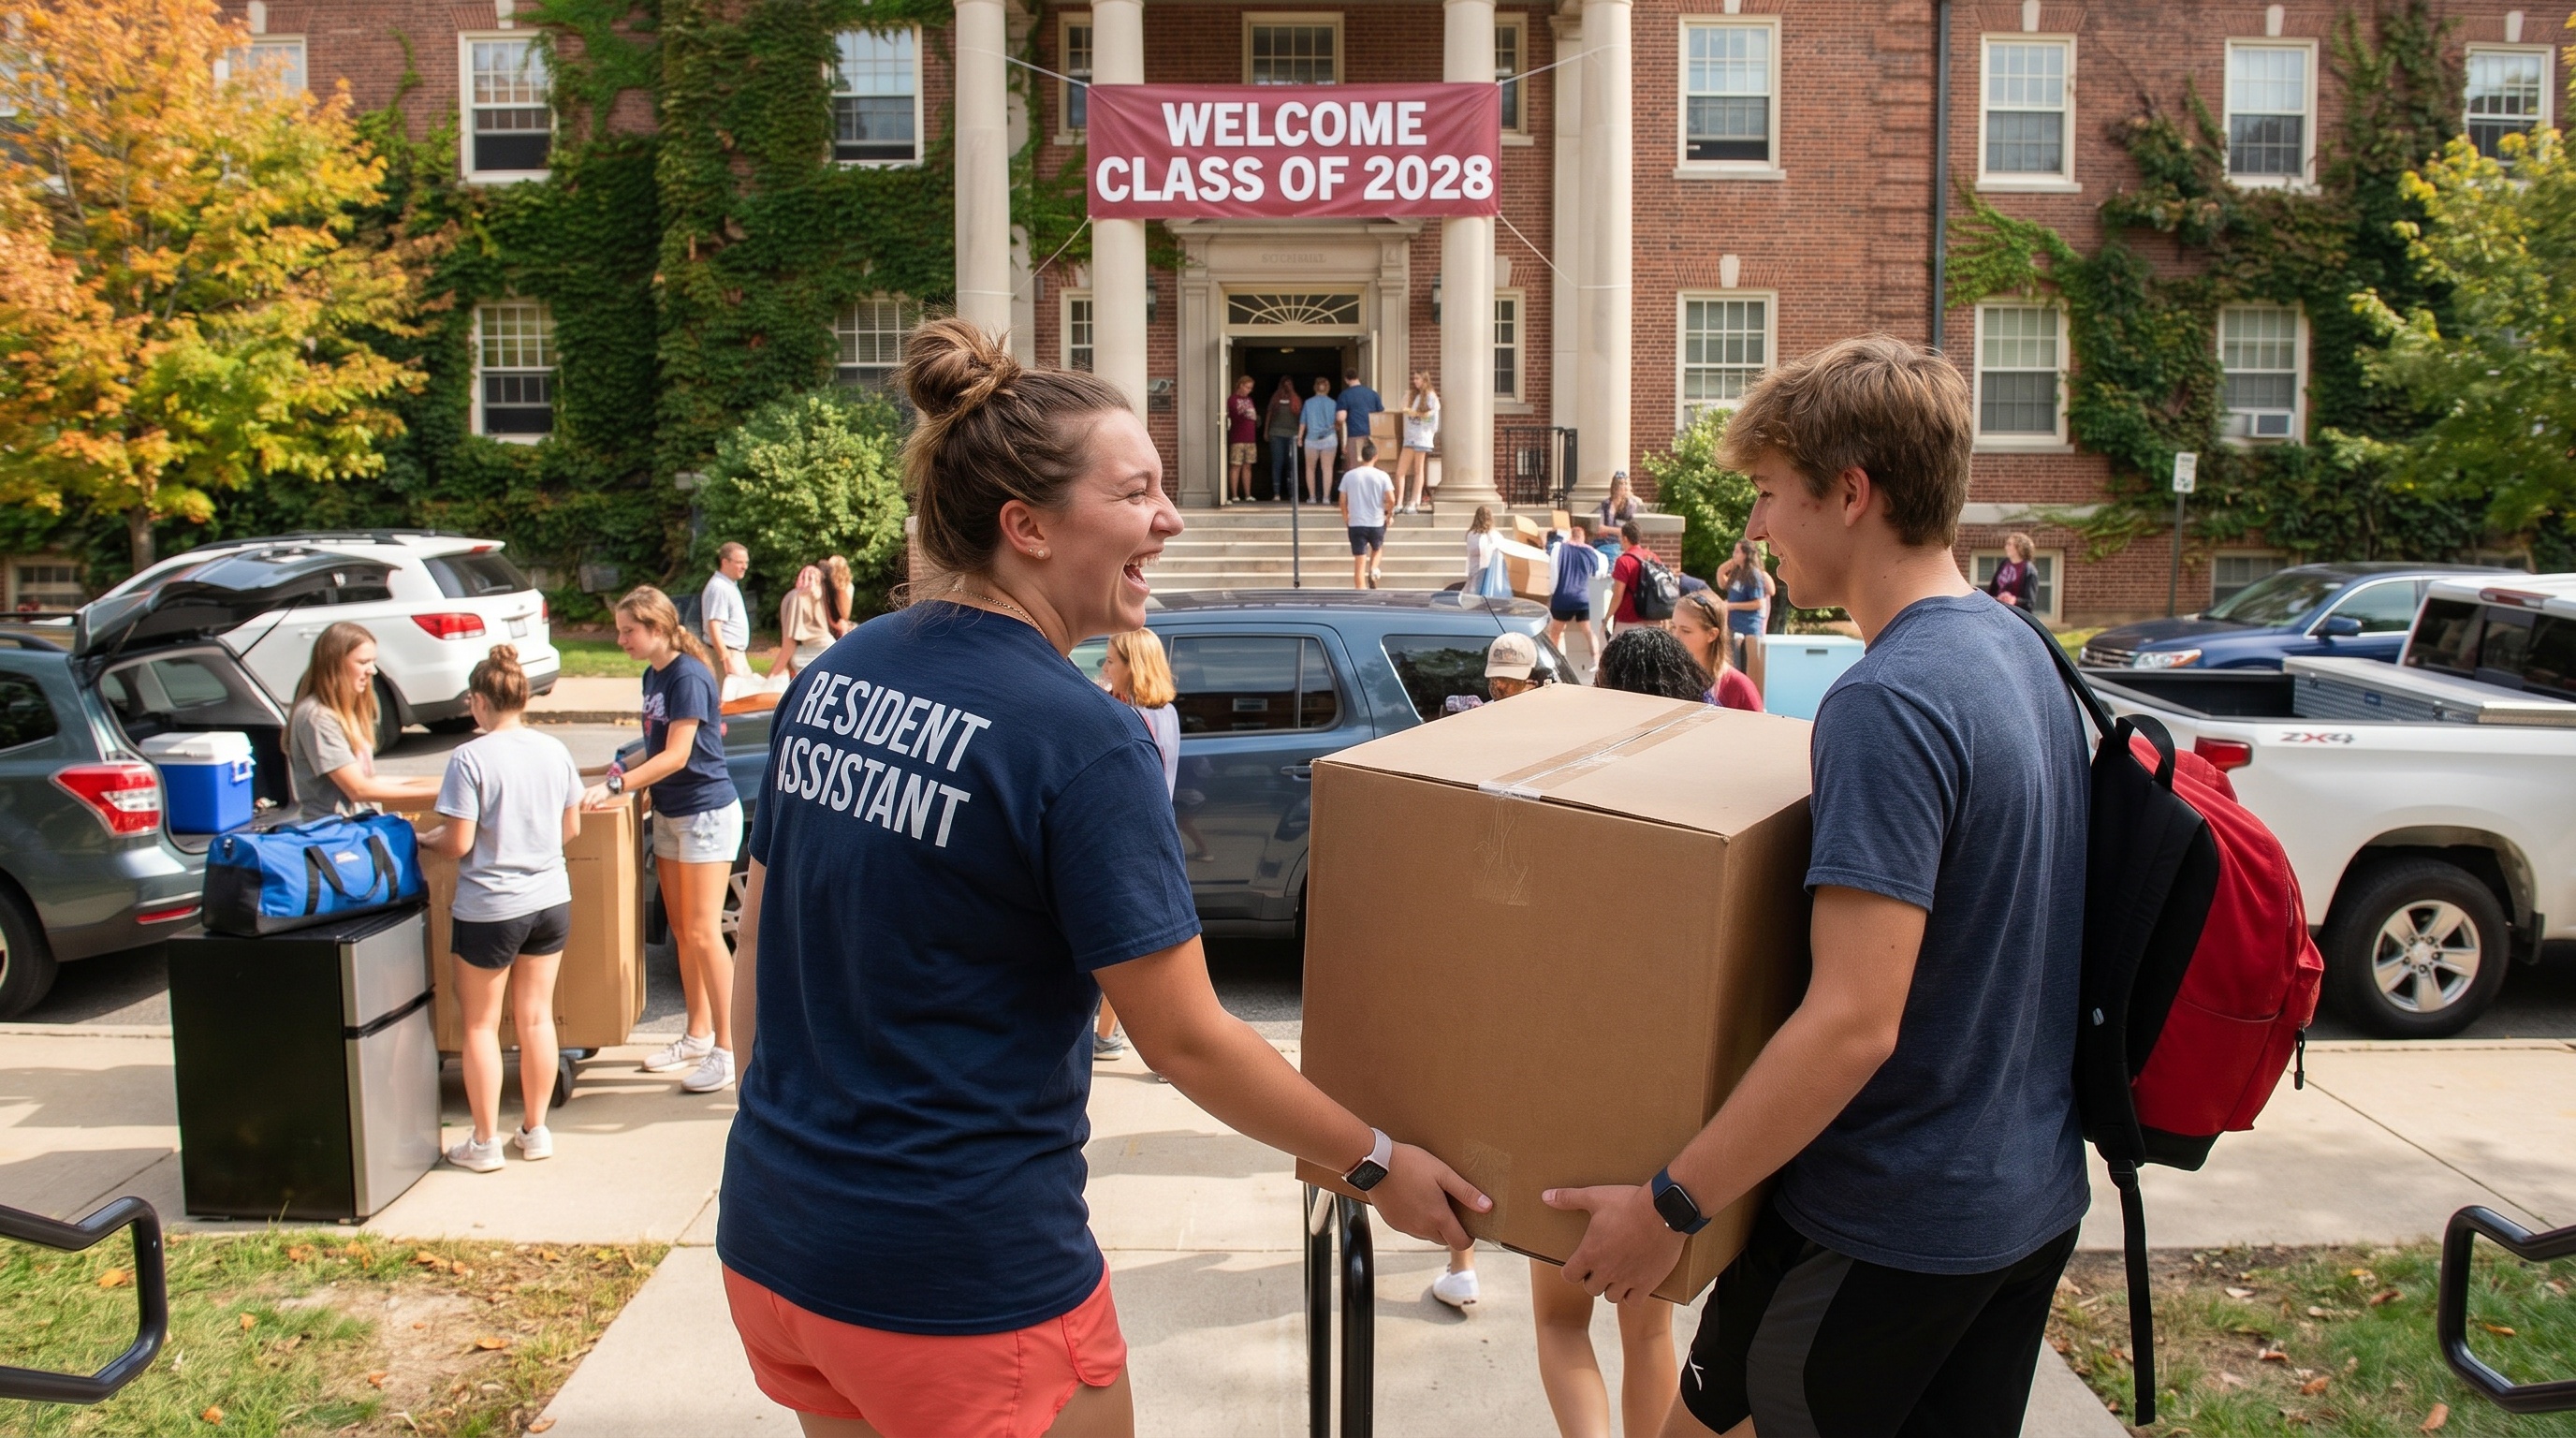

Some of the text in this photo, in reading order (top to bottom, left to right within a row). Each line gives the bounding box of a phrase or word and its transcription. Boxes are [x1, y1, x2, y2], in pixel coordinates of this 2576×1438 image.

[1161, 100, 1427, 147] WELCOME
[1095, 154, 1494, 203] CLASS OF 2028
[796, 670, 992, 772] RESIDENT
[777, 735, 972, 848] ASSISTANT
